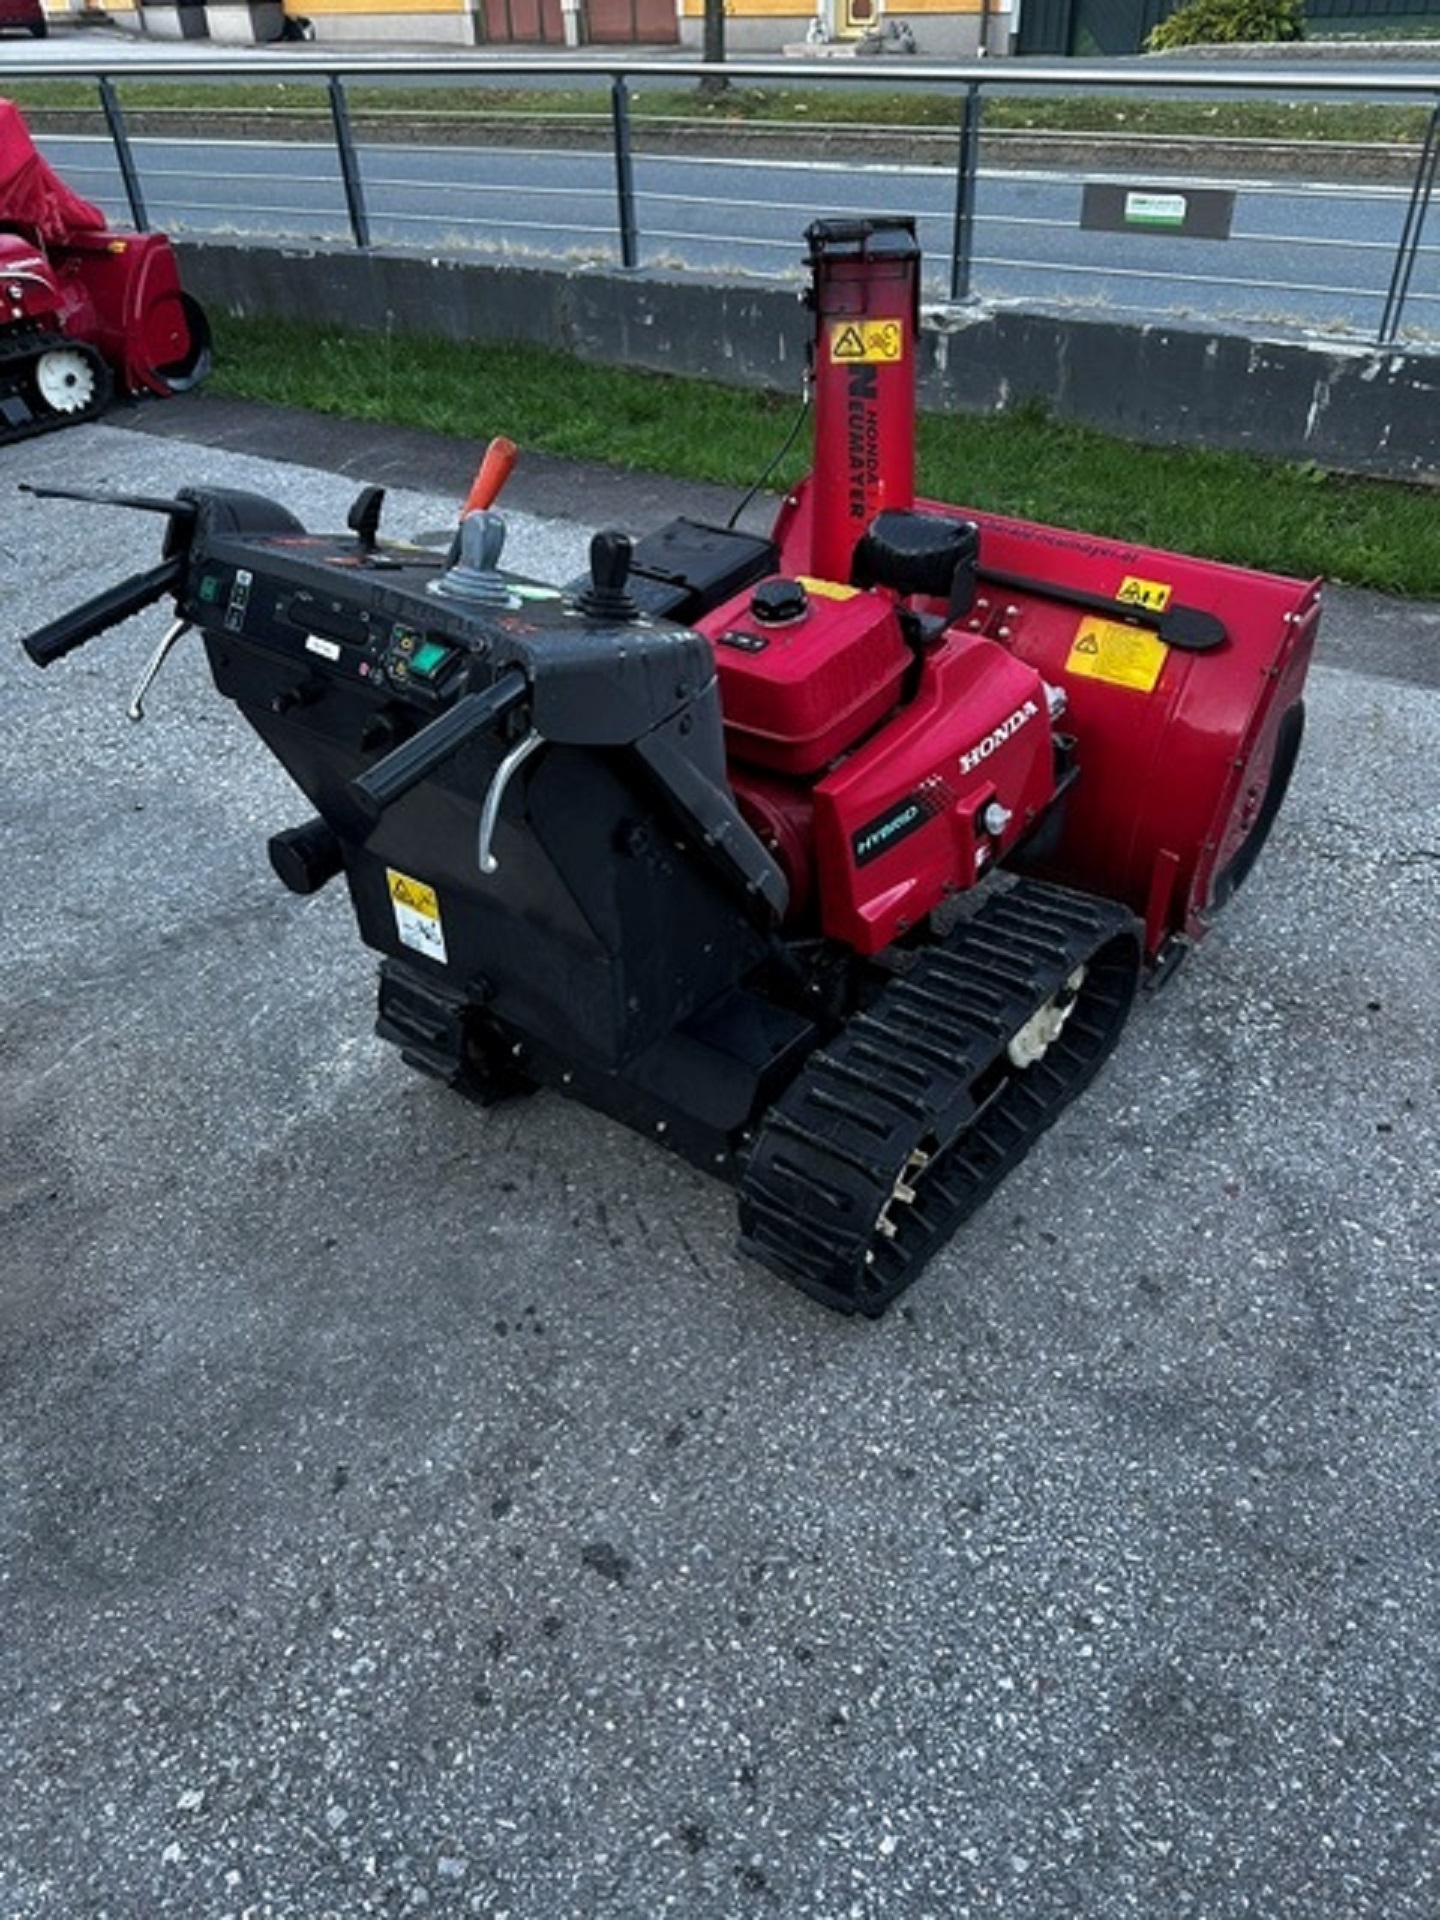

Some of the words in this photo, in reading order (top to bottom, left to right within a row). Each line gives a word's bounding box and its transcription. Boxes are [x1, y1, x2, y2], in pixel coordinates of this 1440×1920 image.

[847, 363, 879, 519] NEUMAYER
[866, 409, 879, 485] HONDA
[958, 701, 1039, 775] HONDA
[856, 805, 919, 855] HYBRID
